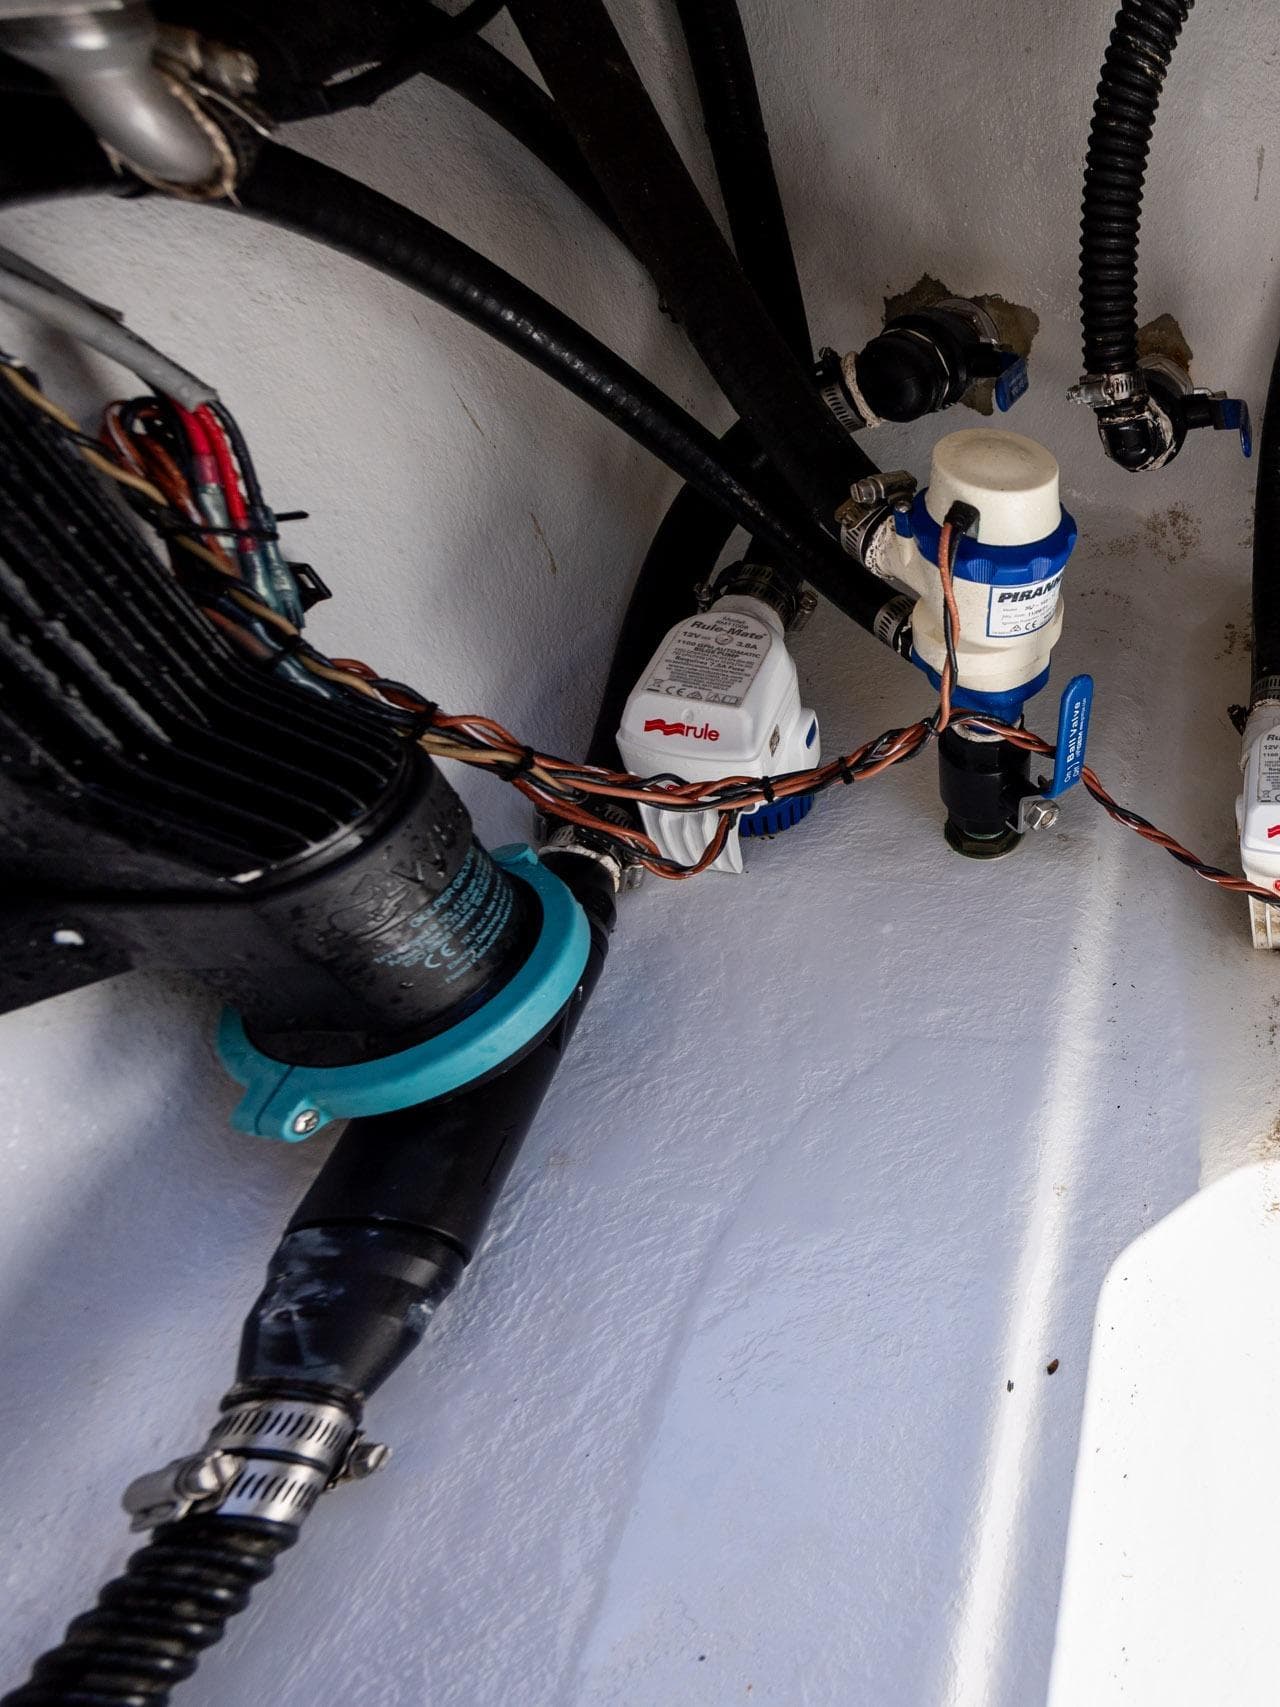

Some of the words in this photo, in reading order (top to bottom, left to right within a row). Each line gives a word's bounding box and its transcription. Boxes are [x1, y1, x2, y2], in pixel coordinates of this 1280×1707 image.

[682, 631, 701, 639] 12V
[716, 646, 761, 659] AUTOMATIC
[1070, 702, 1080, 738] Valve
[685, 723, 720, 741] rule
[1067, 738, 1076, 763] Ball
